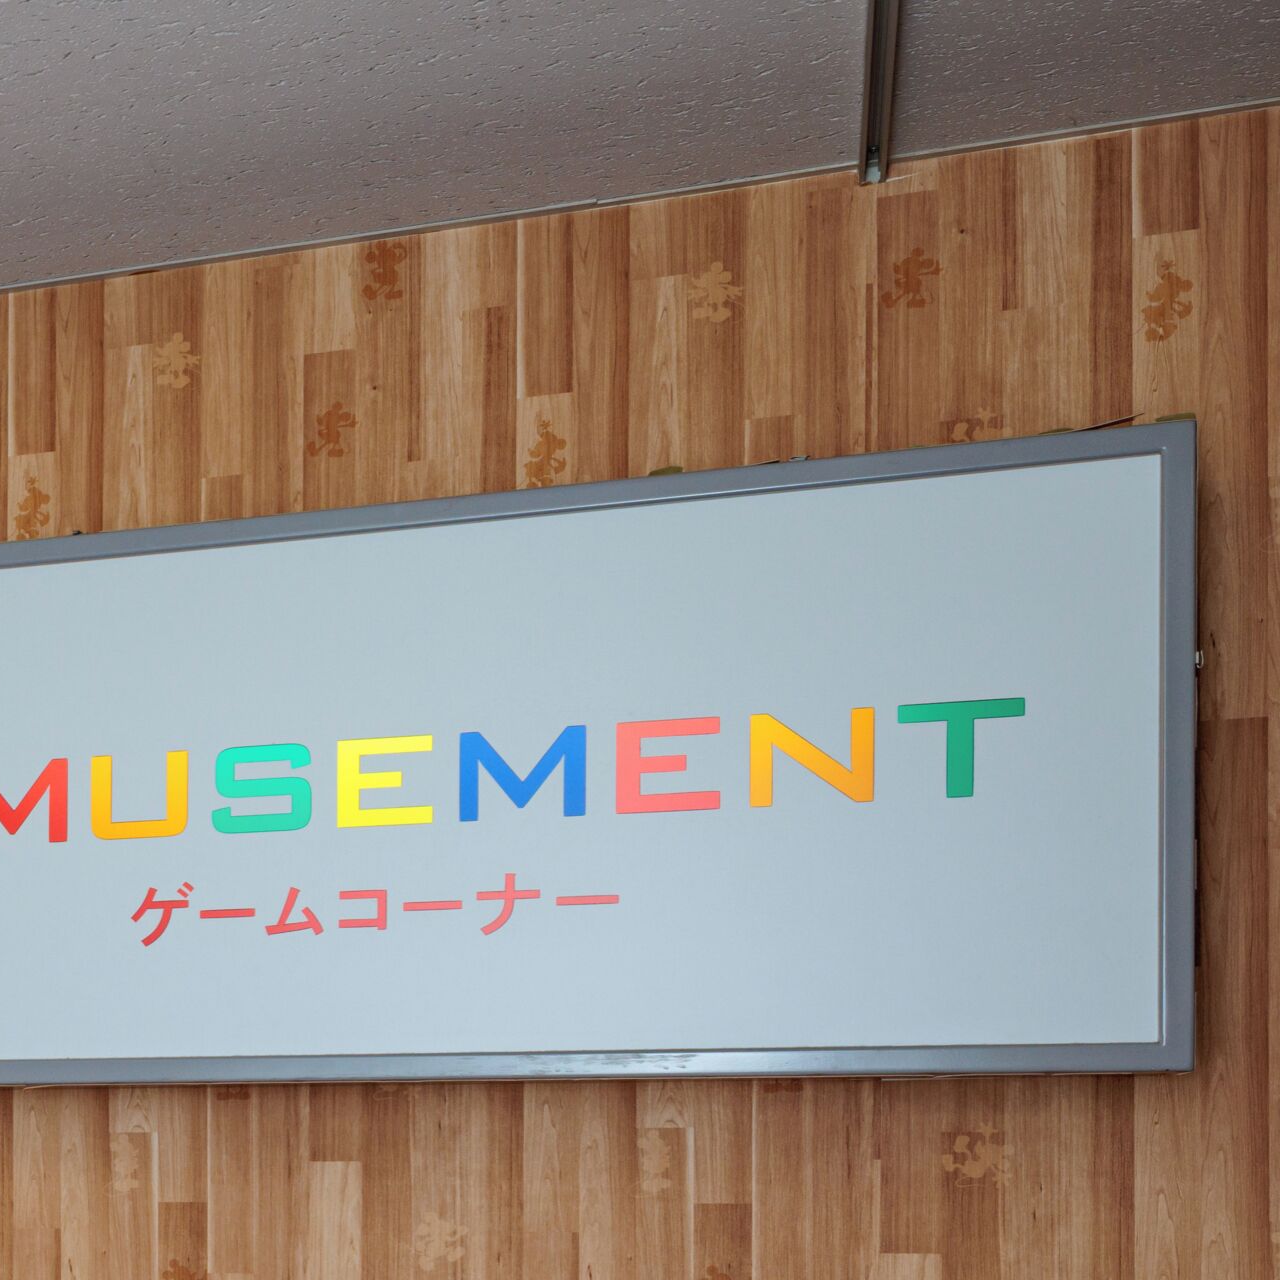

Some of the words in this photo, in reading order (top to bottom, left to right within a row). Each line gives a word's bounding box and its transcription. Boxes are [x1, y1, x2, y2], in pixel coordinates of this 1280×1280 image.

[130, 873, 620, 946] ゲームコーナー
